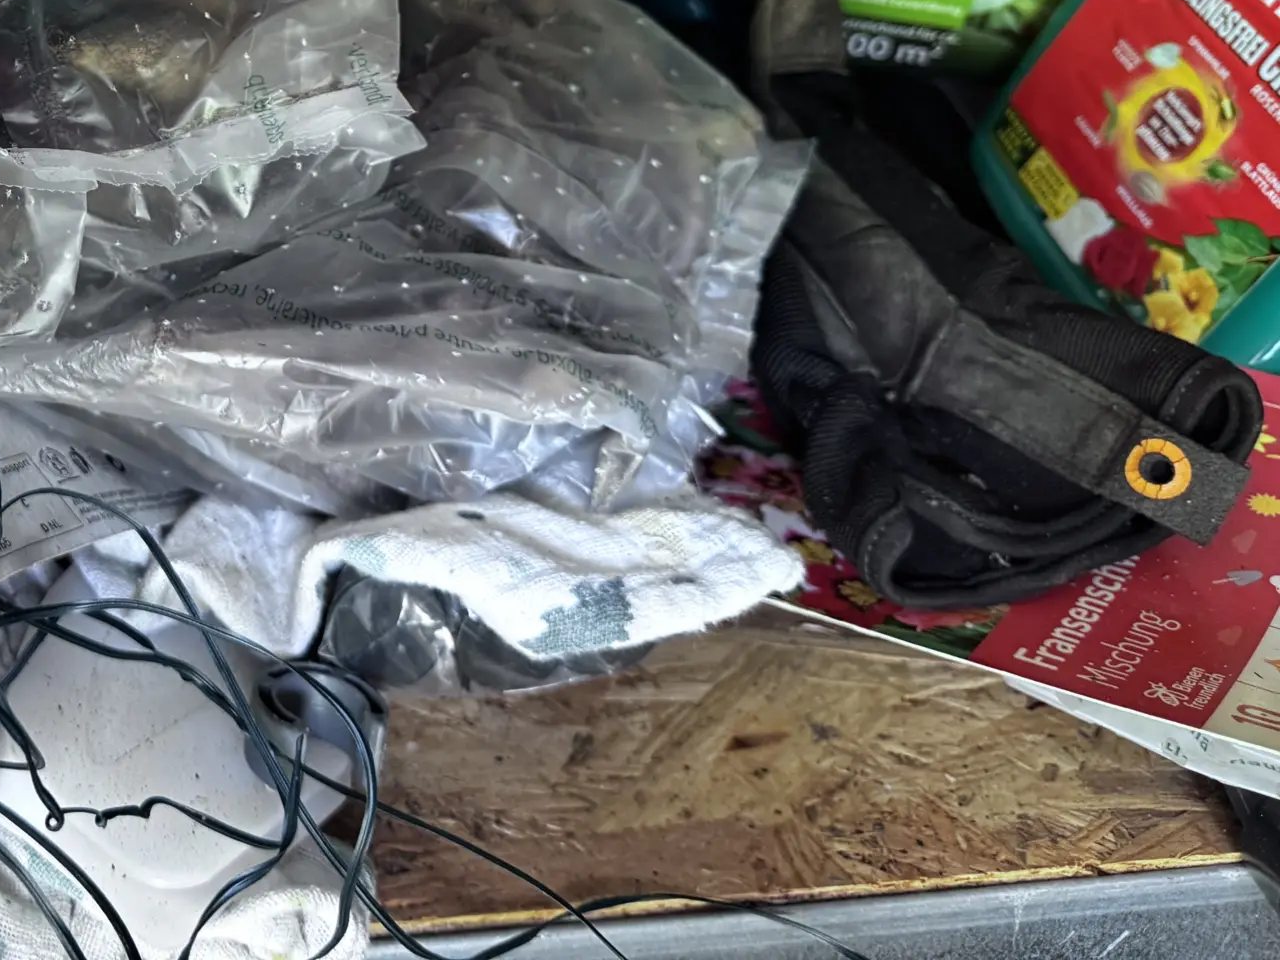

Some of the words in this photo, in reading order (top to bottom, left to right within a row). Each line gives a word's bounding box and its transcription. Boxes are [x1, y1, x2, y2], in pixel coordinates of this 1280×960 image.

[1077, 608, 1182, 690] Mischung
[1171, 666, 1207, 694] Bienen
[1184, 672, 1227, 711] freundlich
